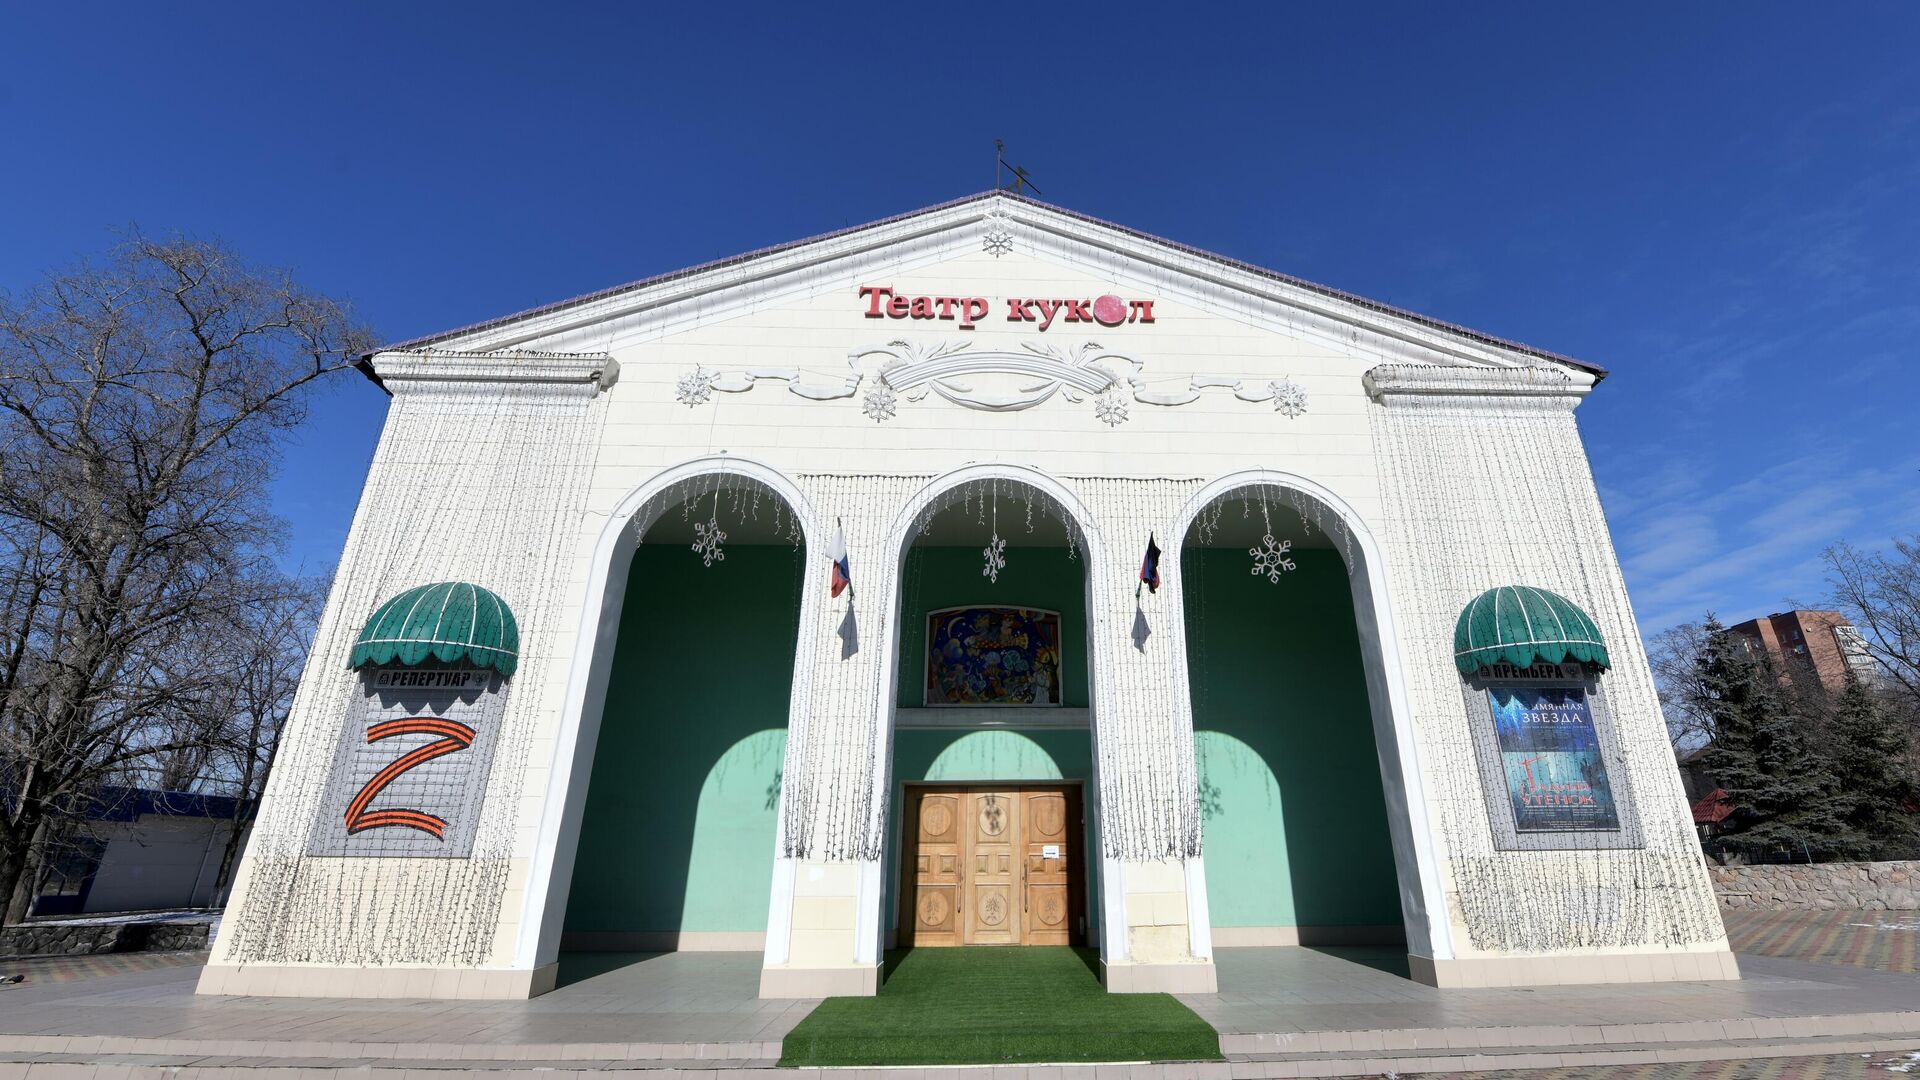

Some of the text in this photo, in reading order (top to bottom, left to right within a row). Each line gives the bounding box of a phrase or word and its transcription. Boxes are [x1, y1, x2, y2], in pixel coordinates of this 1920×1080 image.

[859, 286, 1155, 332] Театр кукол
[1492, 664, 1564, 678] ПРЕМЬЕРА
[391, 671, 470, 686] РЕПЕРТУАР
[1522, 712, 1583, 724] ЗВЕЗДА
